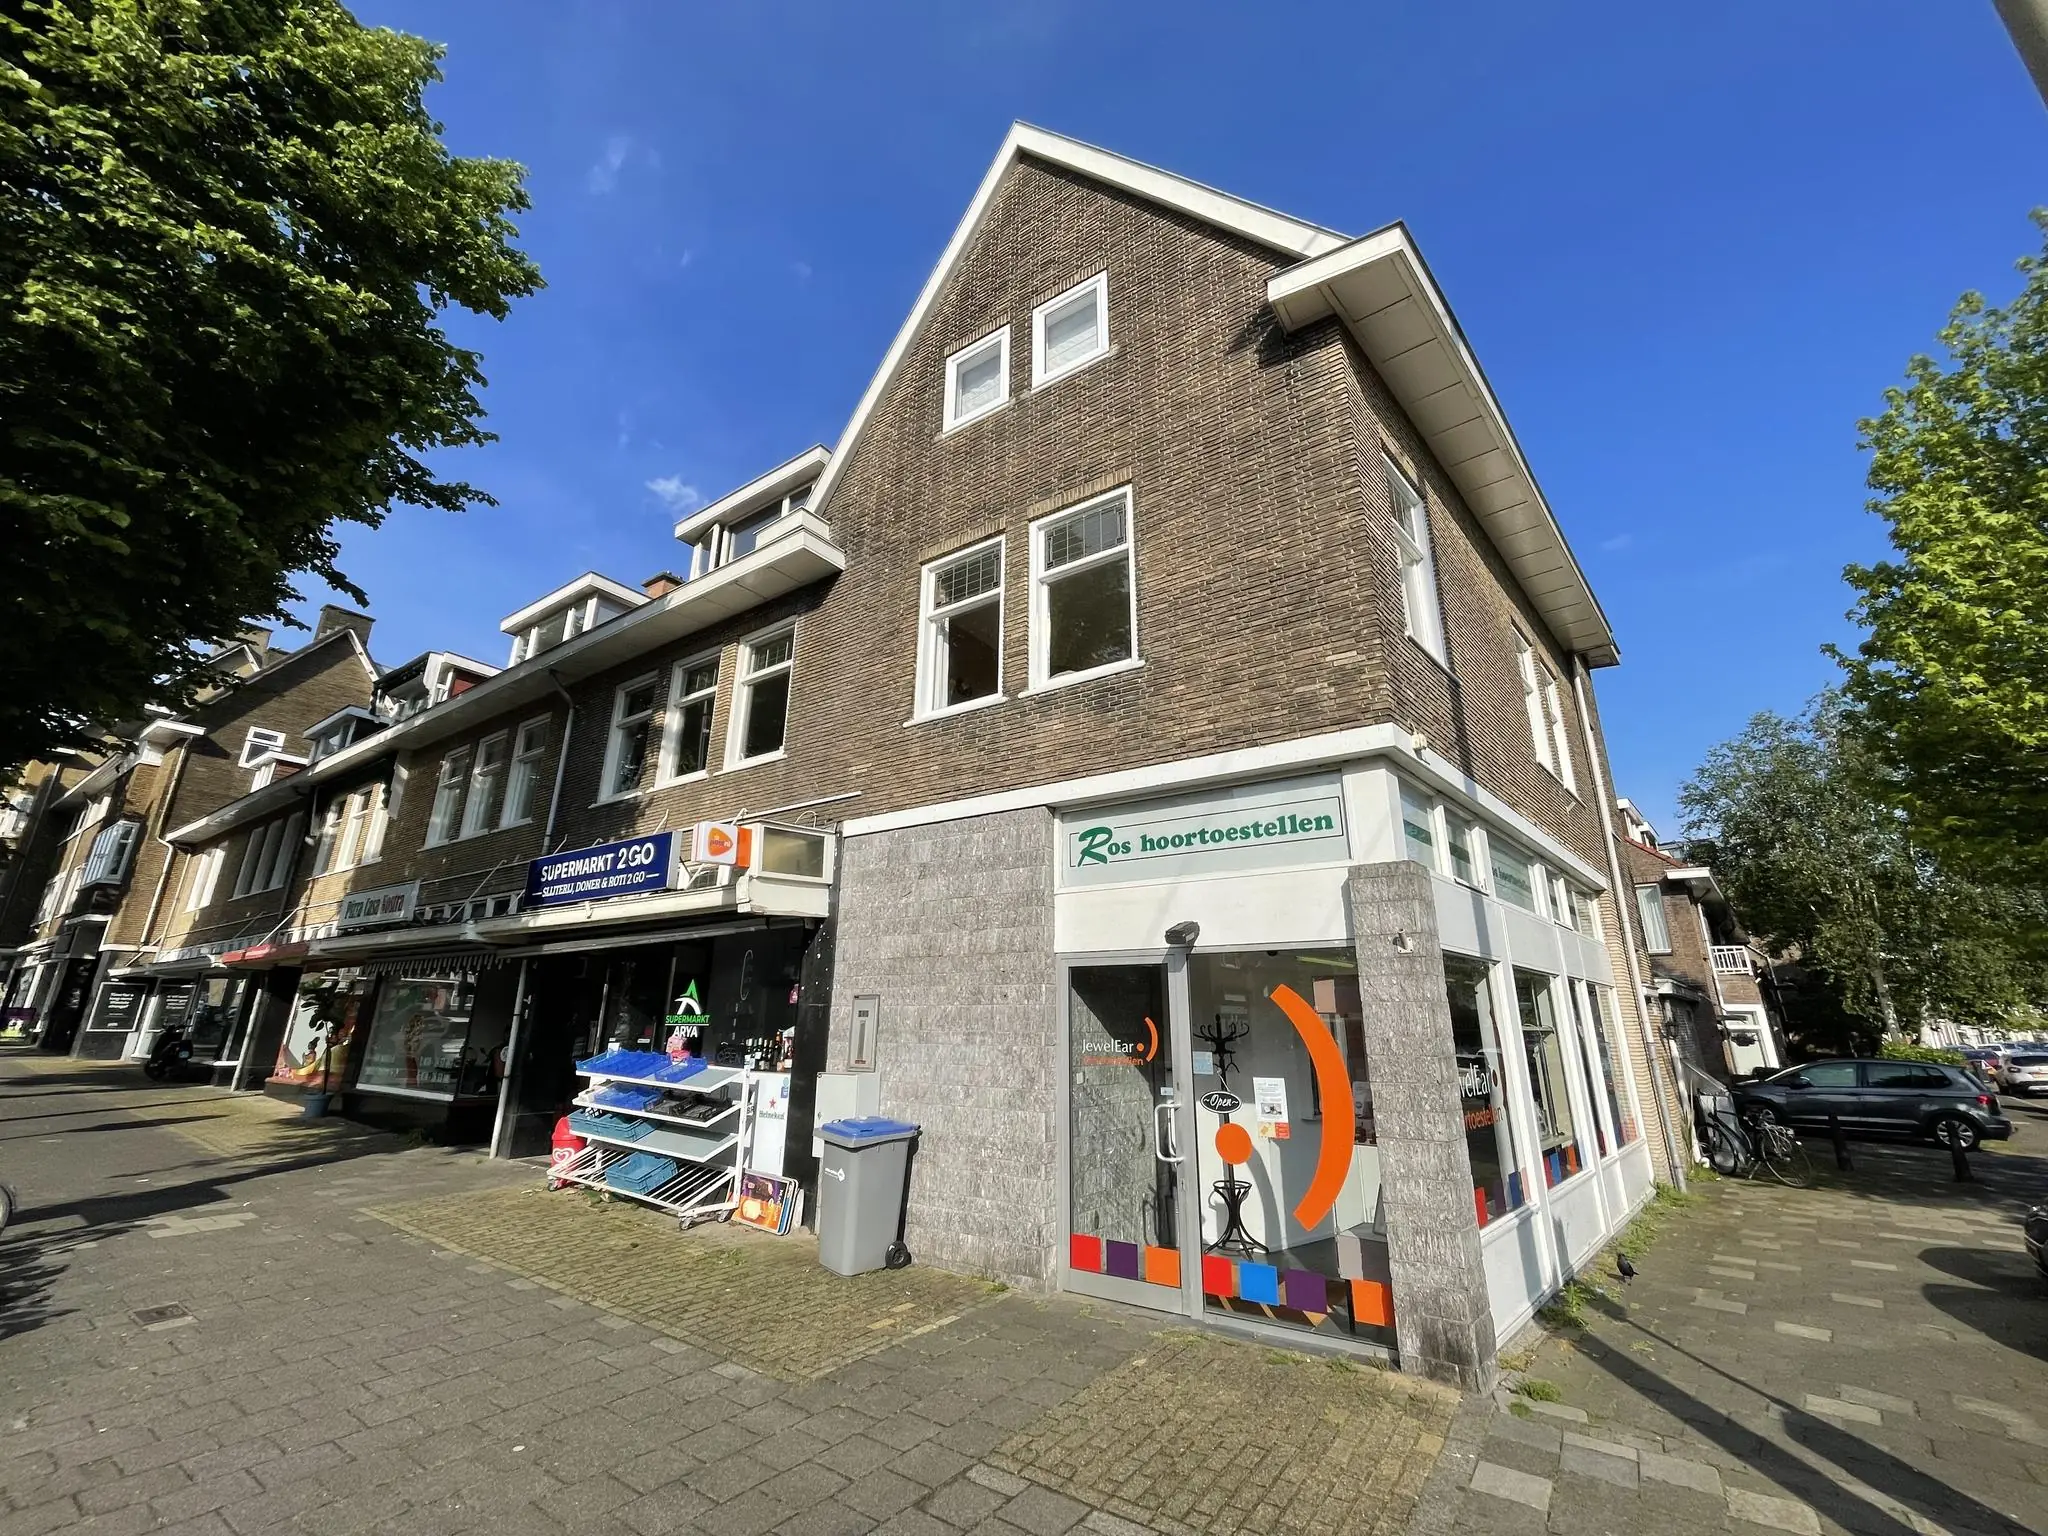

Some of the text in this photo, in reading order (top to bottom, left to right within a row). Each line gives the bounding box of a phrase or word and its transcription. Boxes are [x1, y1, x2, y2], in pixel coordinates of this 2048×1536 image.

[1077, 813, 1334, 867] Ros hoortoestellen
[540, 853, 615, 882] SUPERMARKT
[575, 878, 601, 893] DONER
[601, 877, 608, 889] &
[608, 874, 627, 888] ROTI
[665, 1014, 710, 1024] SUPERMARKT
[672, 1025, 698, 1038] ARYA
[1082, 1038, 1134, 1054] JewelEar
[1210, 1094, 1232, 1110] Open
